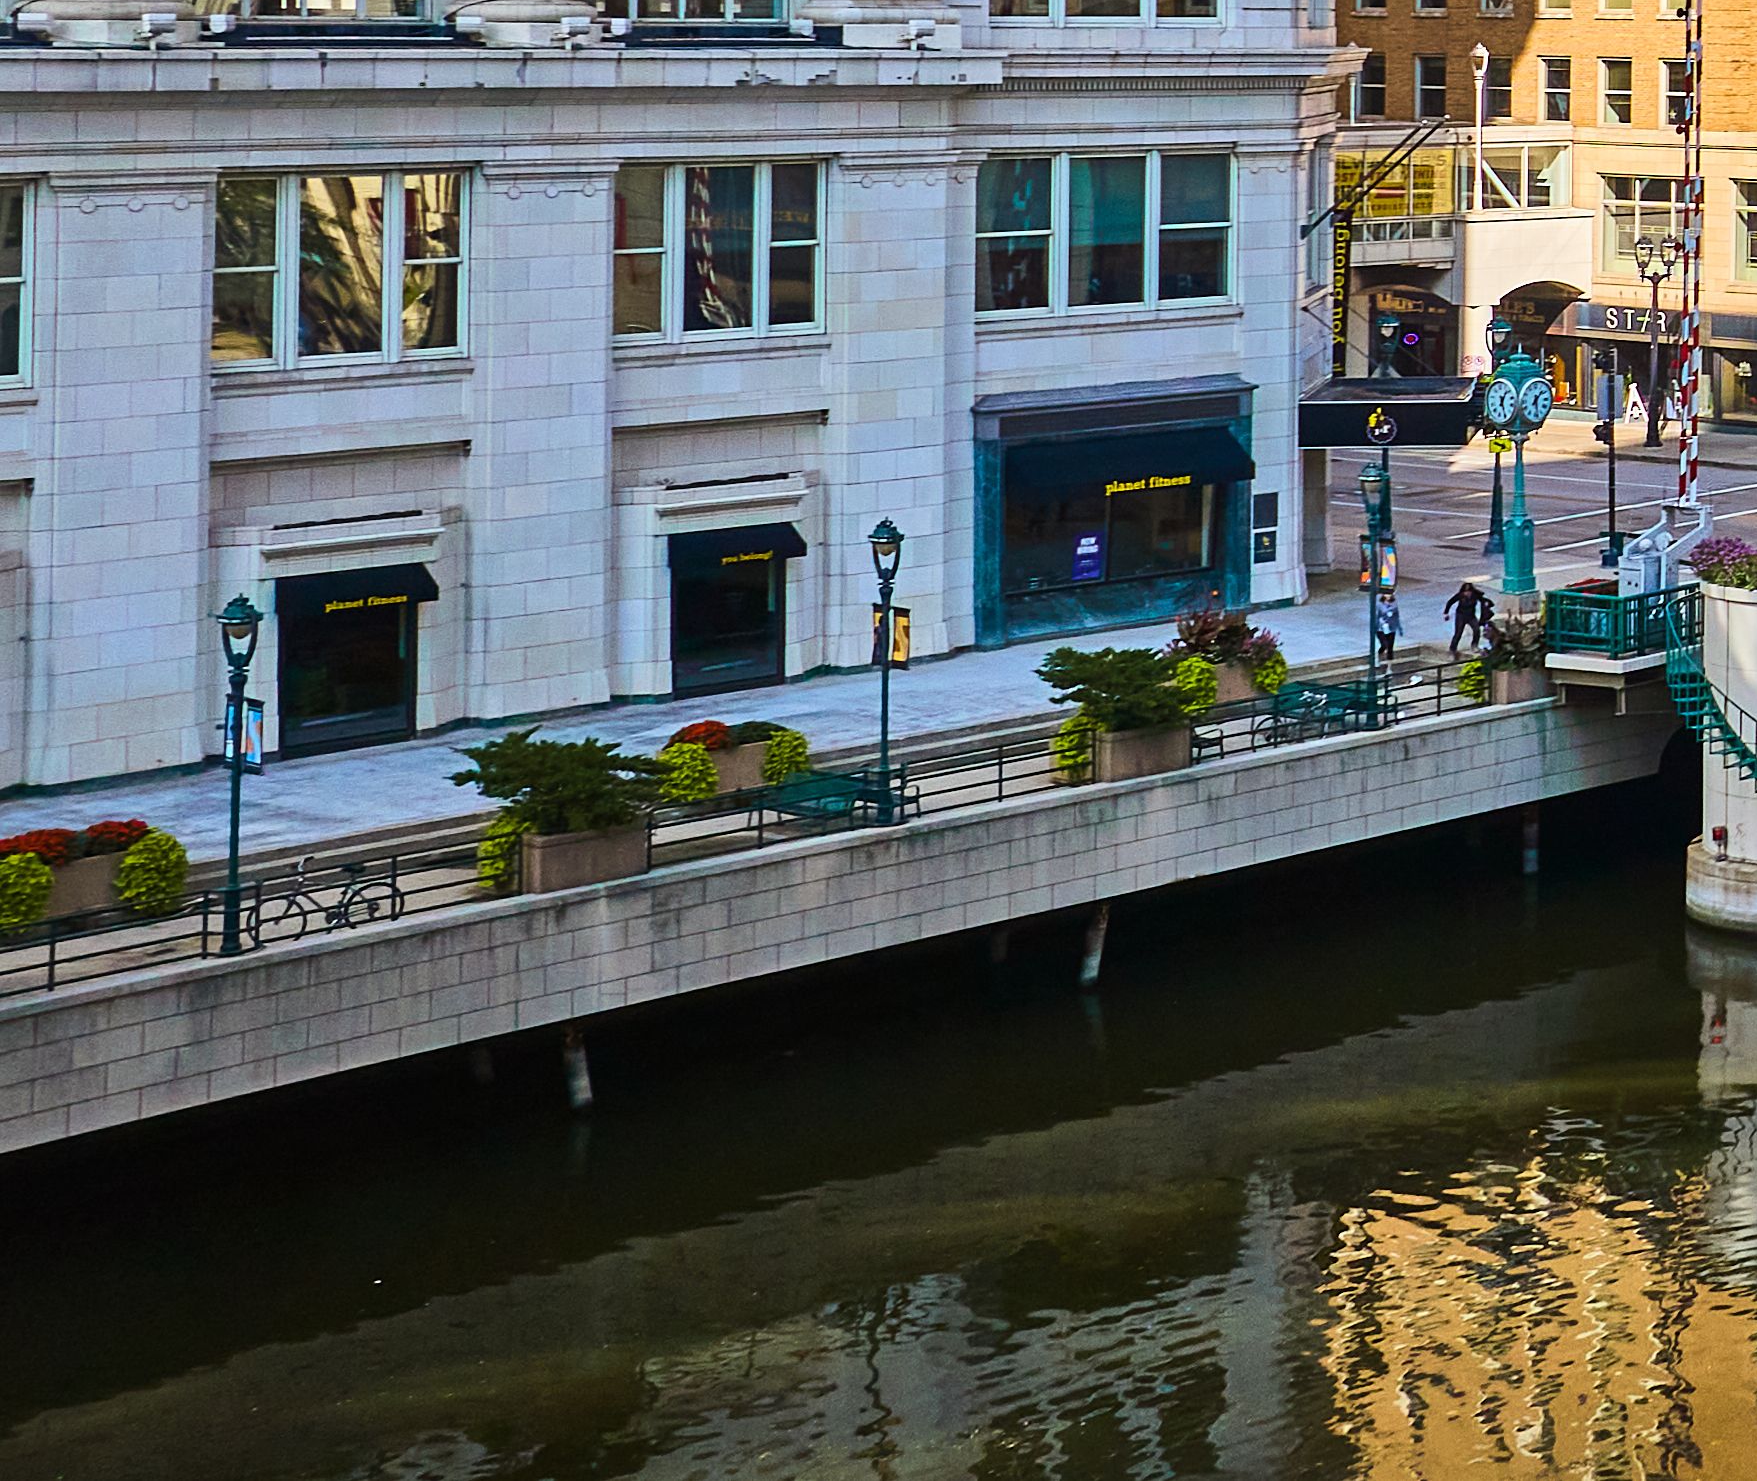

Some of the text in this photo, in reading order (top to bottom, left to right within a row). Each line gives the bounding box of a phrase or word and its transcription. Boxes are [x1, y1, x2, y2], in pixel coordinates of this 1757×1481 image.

[1332, 307, 1345, 344] you
[1105, 475, 1191, 496] planet fitness
